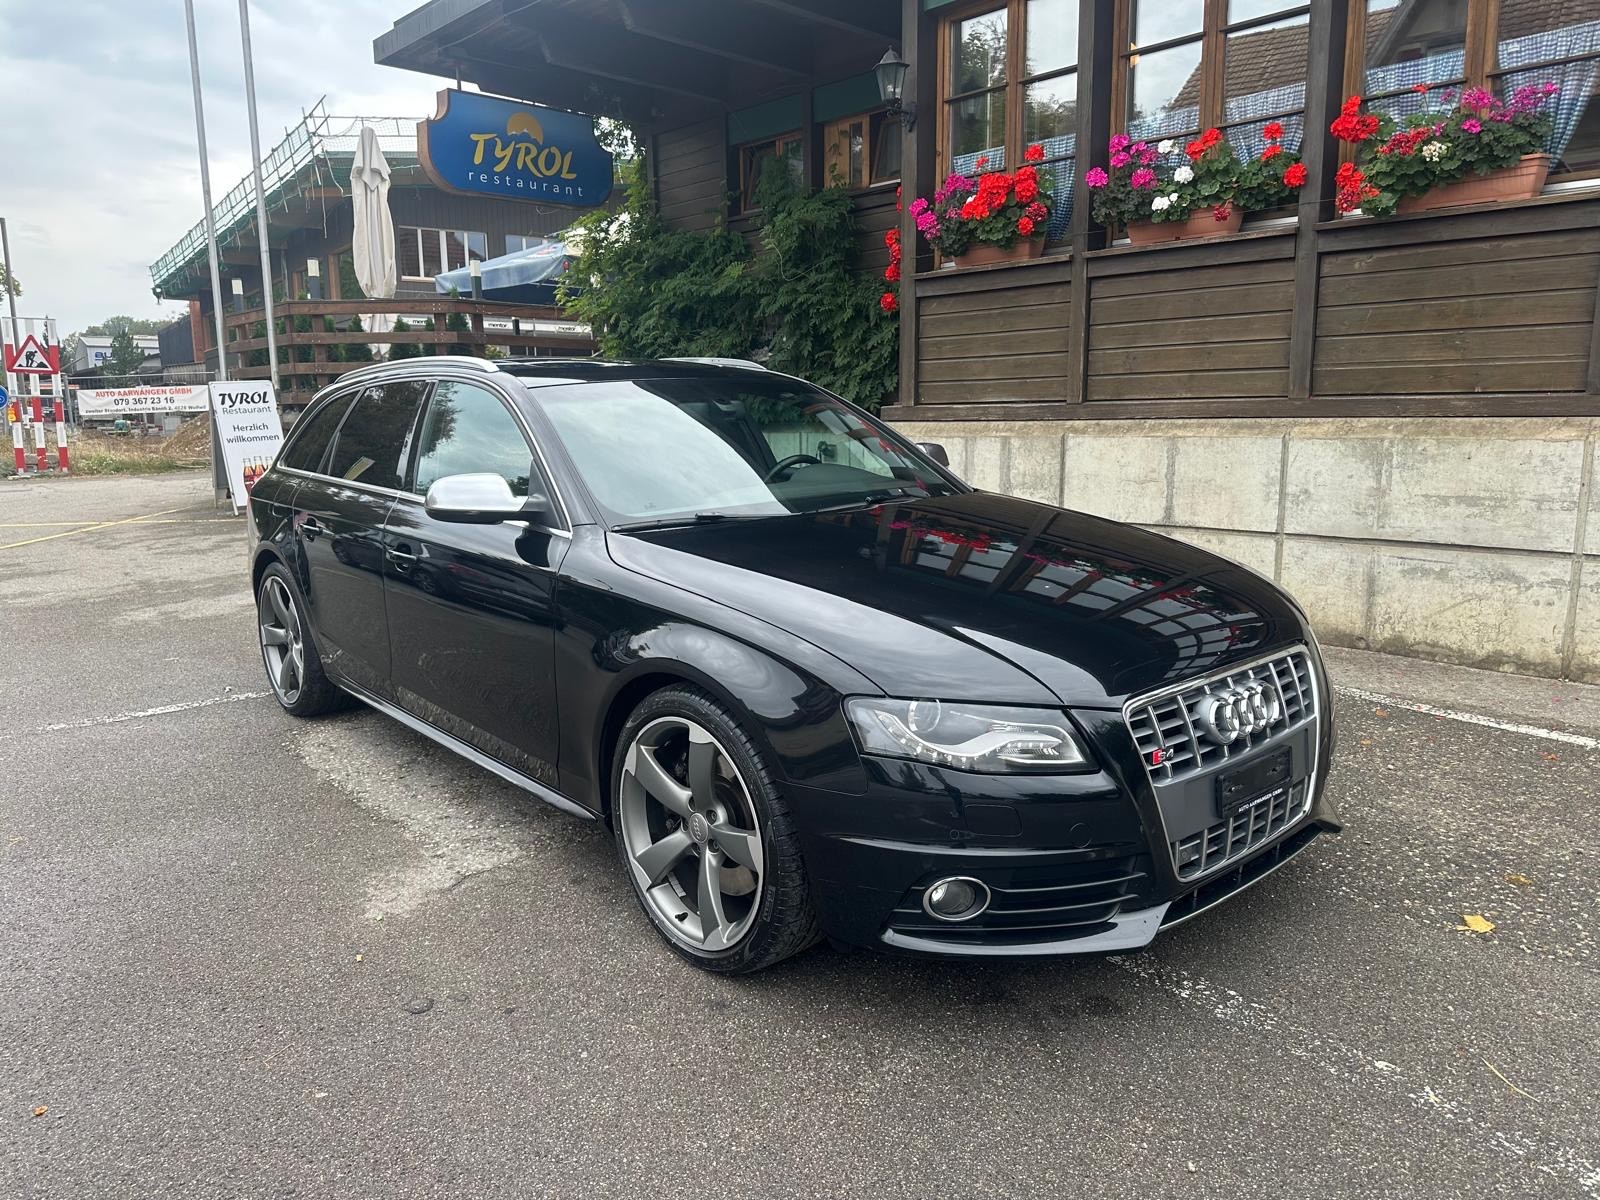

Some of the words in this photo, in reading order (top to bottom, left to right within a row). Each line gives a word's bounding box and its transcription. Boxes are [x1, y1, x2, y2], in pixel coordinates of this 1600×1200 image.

[470, 133, 577, 179] TYROL
[468, 171, 583, 197] restaurant
[95, 390, 116, 398] AUTO
[117, 389, 167, 397] AARWANGEN
[168, 387, 193, 395] GMBH
[113, 398, 130, 406] 079
[132, 397, 148, 405] 367
[150, 396, 161, 405] 23
[164, 396, 175, 404] 16
[218, 391, 270, 408] TYROL
[222, 405, 272, 415] Restaurant
[232, 422, 269, 432] Herzlich
[226, 434, 280, 444] willkommen
